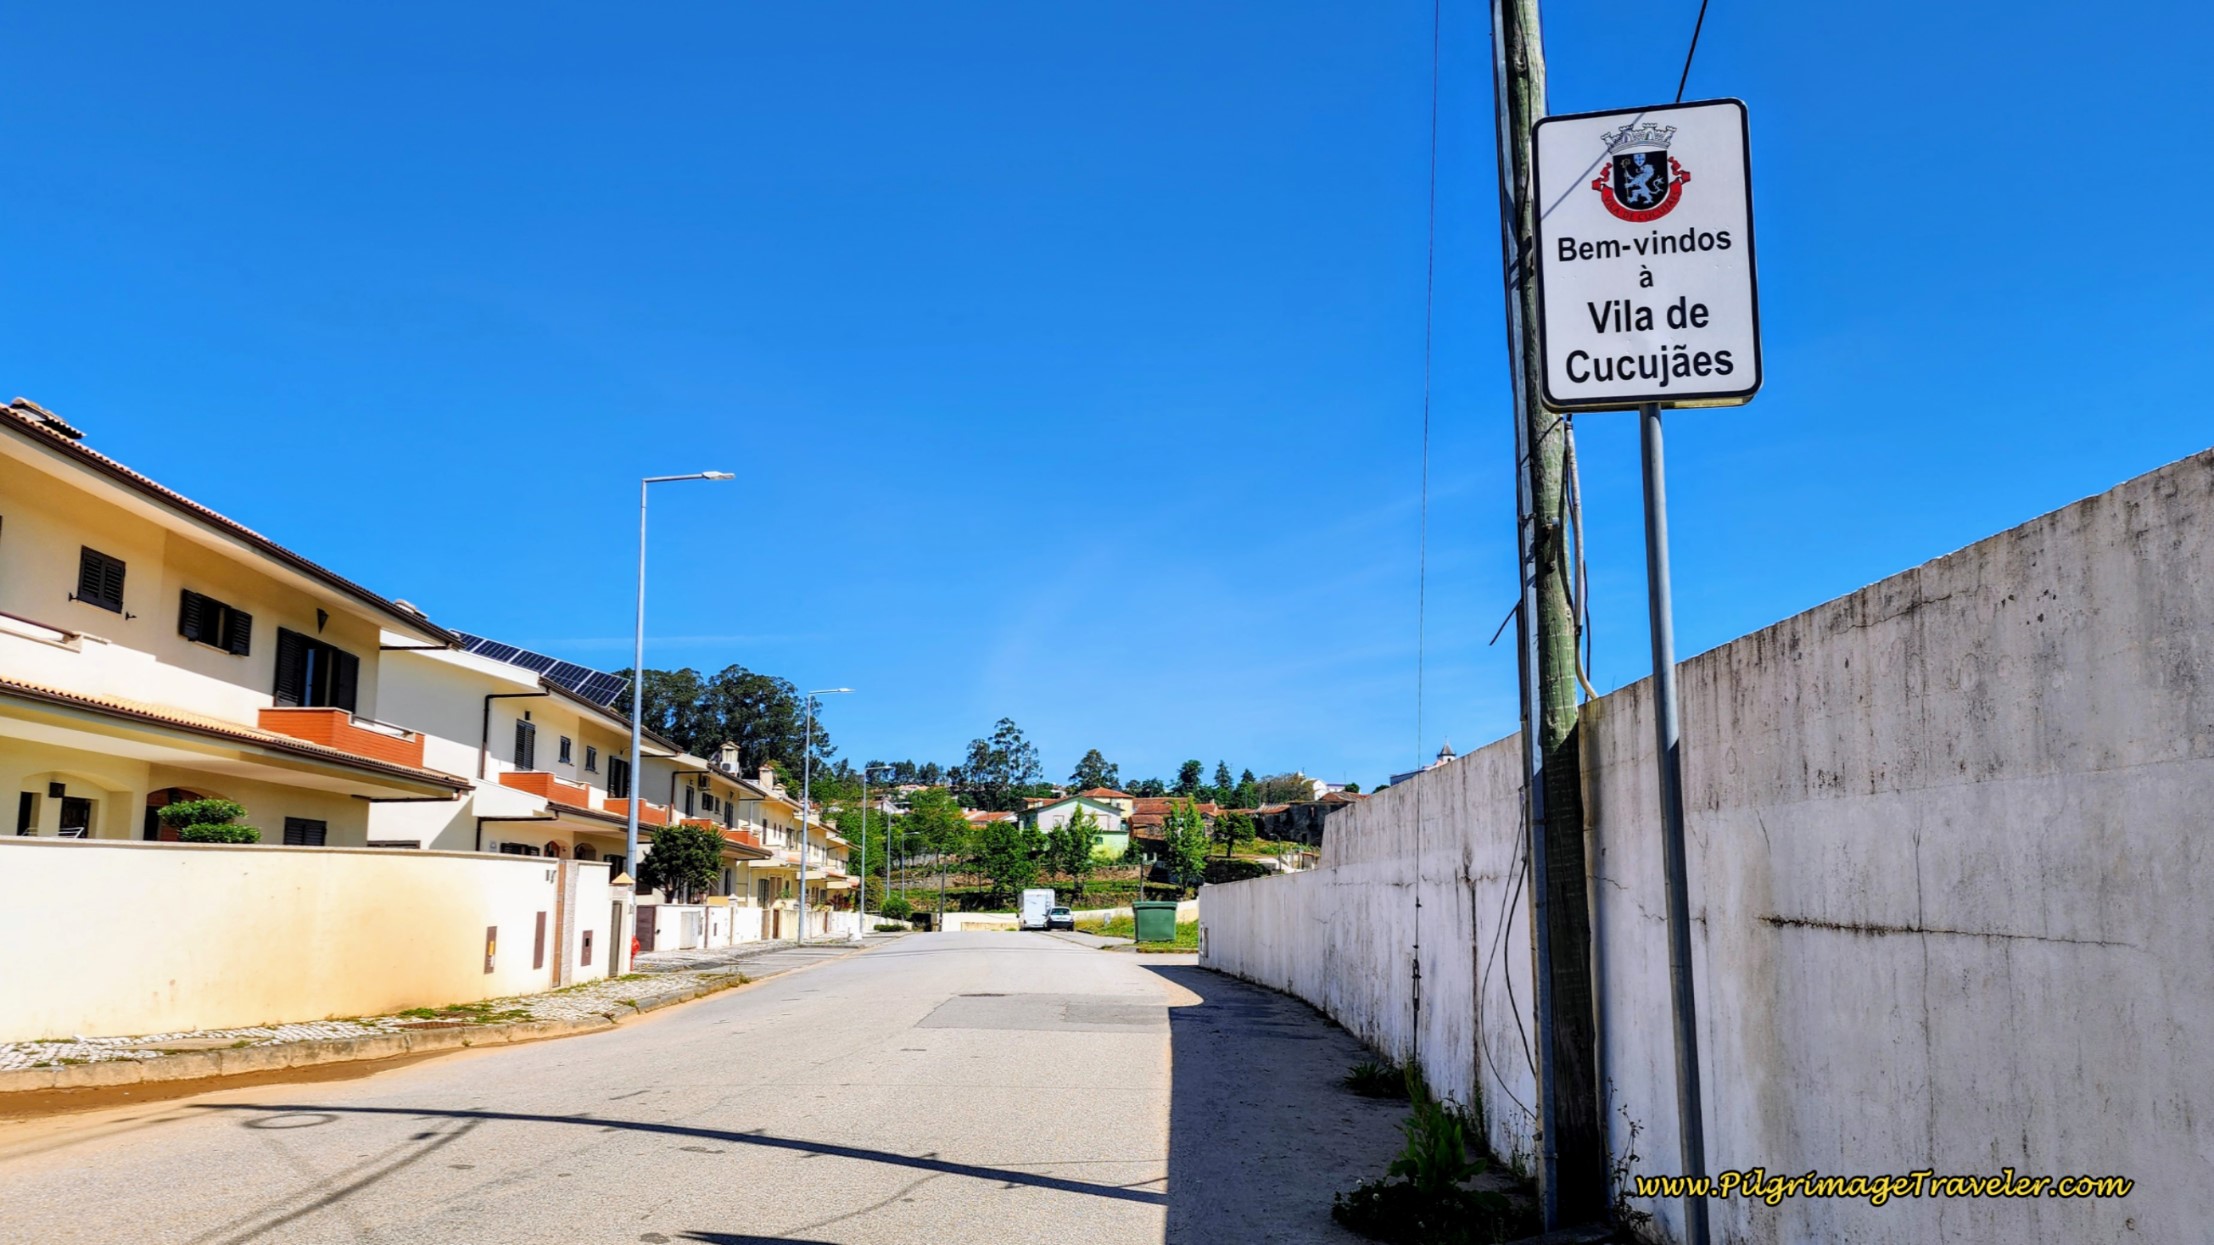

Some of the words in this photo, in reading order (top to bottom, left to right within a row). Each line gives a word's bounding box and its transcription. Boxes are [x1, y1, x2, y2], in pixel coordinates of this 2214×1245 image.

[1558, 226, 1732, 262] Bem-vindos
[1639, 264, 1654, 288] à
[1587, 299, 1654, 334] Vila
[1666, 295, 1709, 329] de
[1566, 344, 1734, 388] Cucujães
